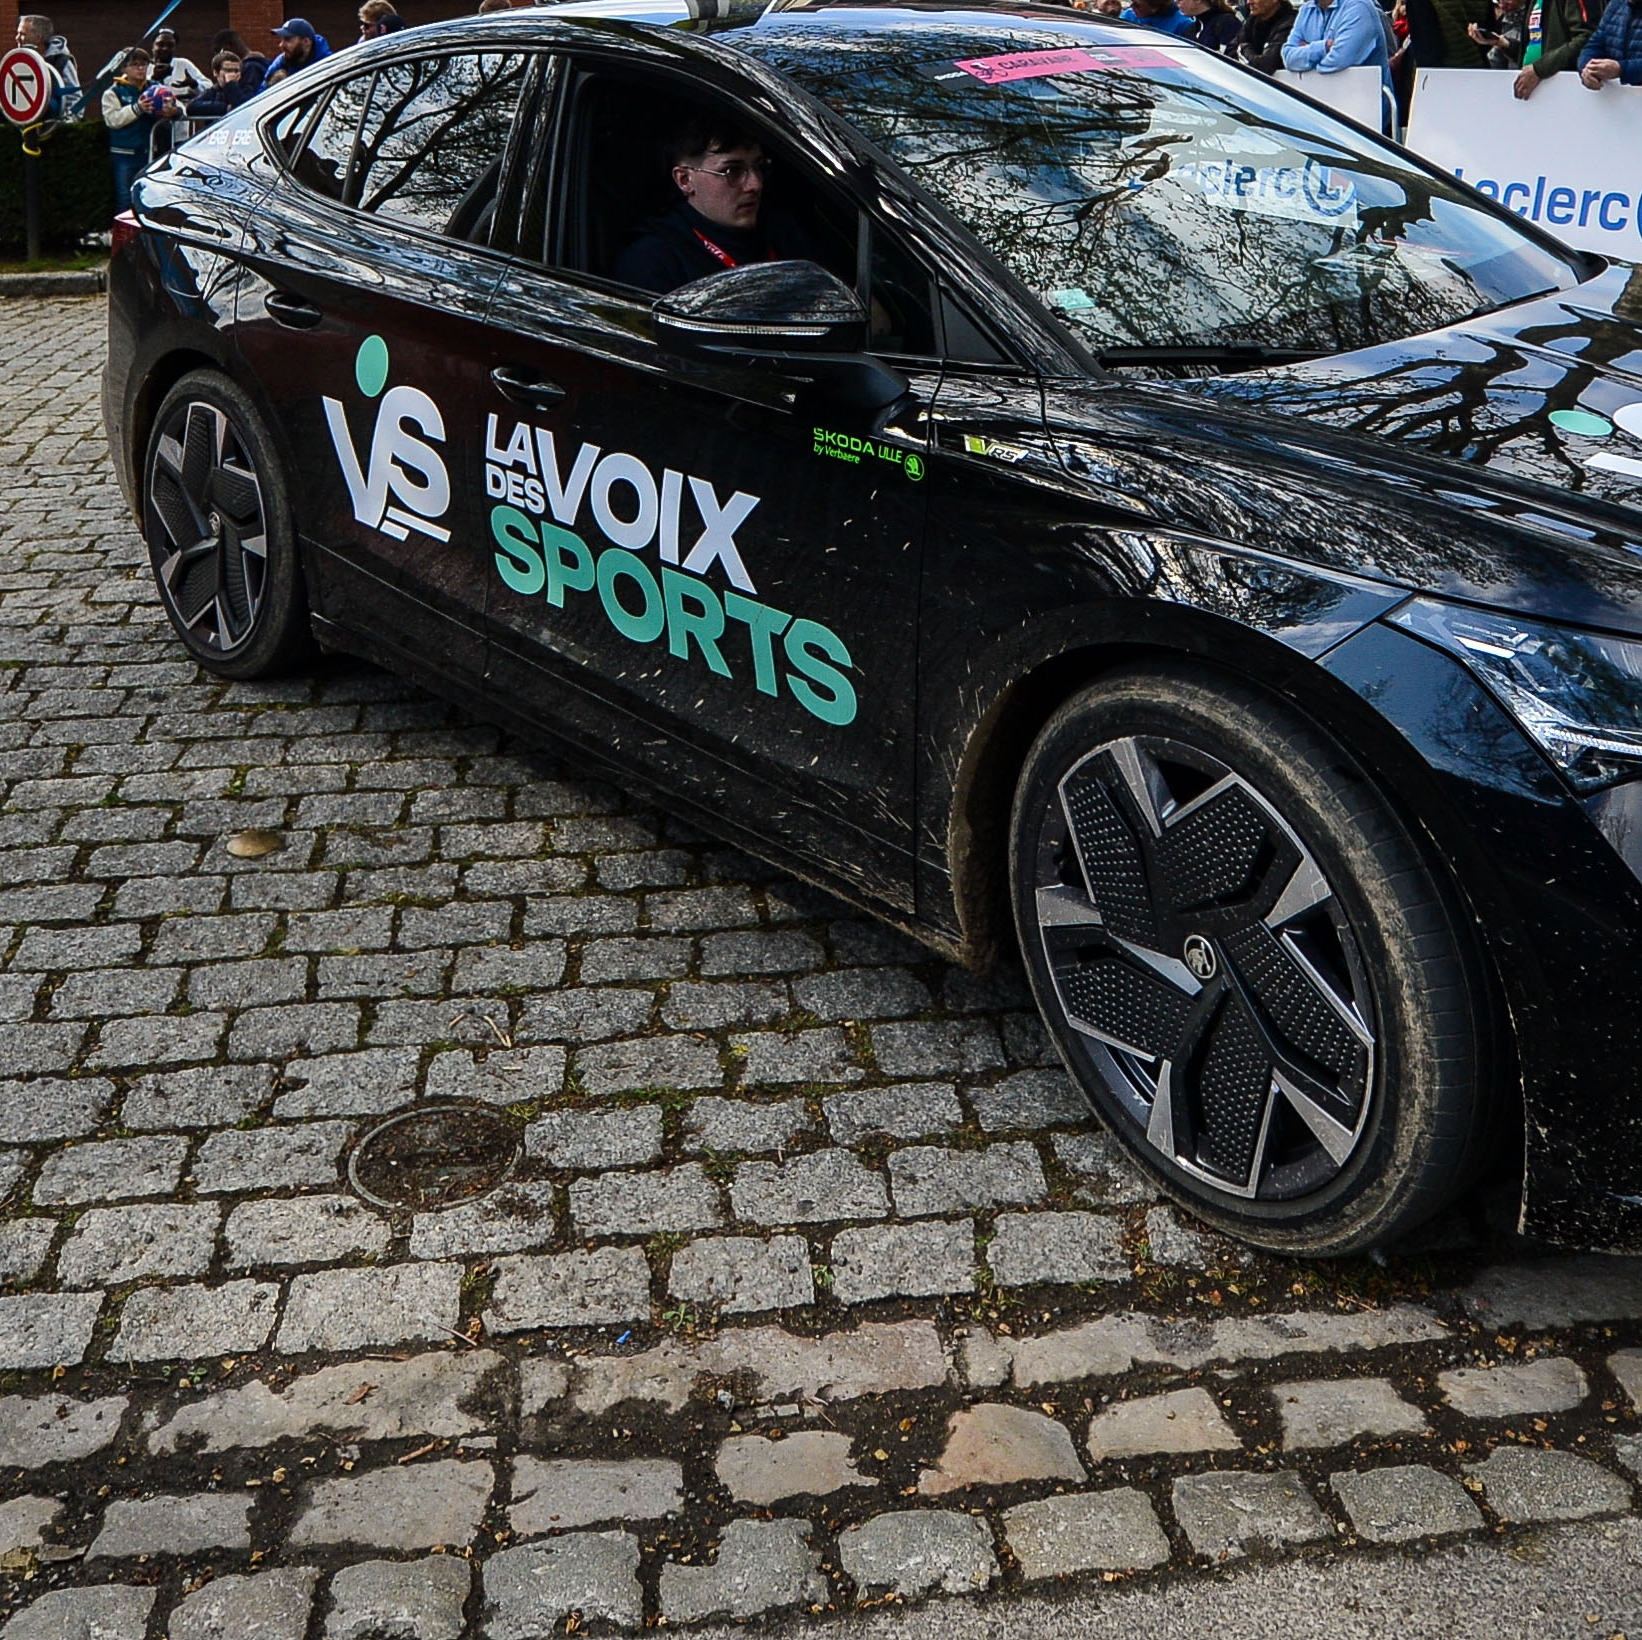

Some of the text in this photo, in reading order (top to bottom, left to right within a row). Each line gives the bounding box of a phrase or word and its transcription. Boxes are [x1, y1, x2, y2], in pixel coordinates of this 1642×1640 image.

[1454, 168, 1630, 232] eclerc
[813, 442, 860, 465] by Verbaere
[991, 447, 1018, 461] RS
[485, 413, 760, 594] LA VOIX
[486, 462, 545, 514] DES
[490, 505, 858, 726] SPORTS
